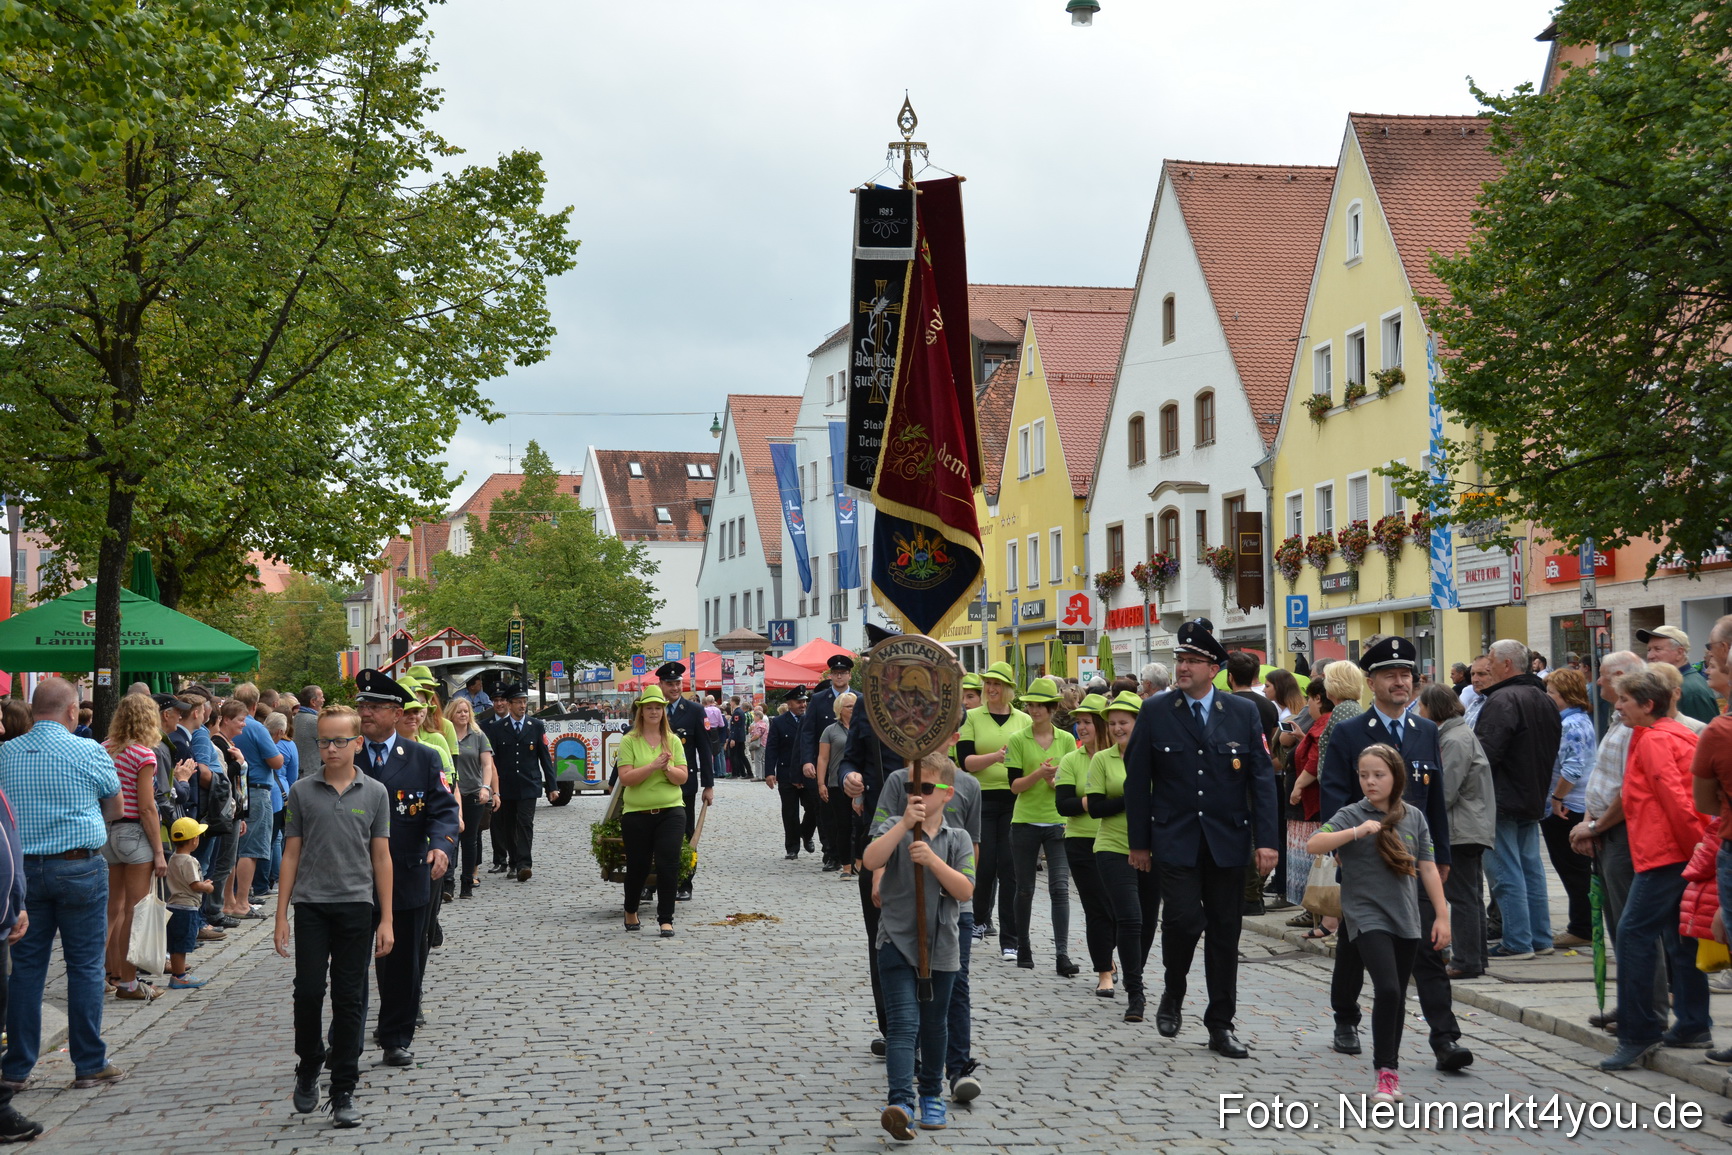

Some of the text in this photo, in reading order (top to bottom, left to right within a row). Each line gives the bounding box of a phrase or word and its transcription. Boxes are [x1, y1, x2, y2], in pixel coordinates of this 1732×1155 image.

[855, 350, 874, 367] Den
[854, 374, 873, 388] zur
[937, 442, 967, 479] dem
[1466, 567, 1501, 583] RIALTO KINO
[1512, 541, 1522, 600] KINO
[1322, 579, 1336, 589] WOLLE
[1020, 602, 1040, 616] TAIFUN
[1291, 599, 1304, 625] P
[1312, 625, 1329, 637] WOLLE
[914, 683, 952, 751] FEUERWEHR
